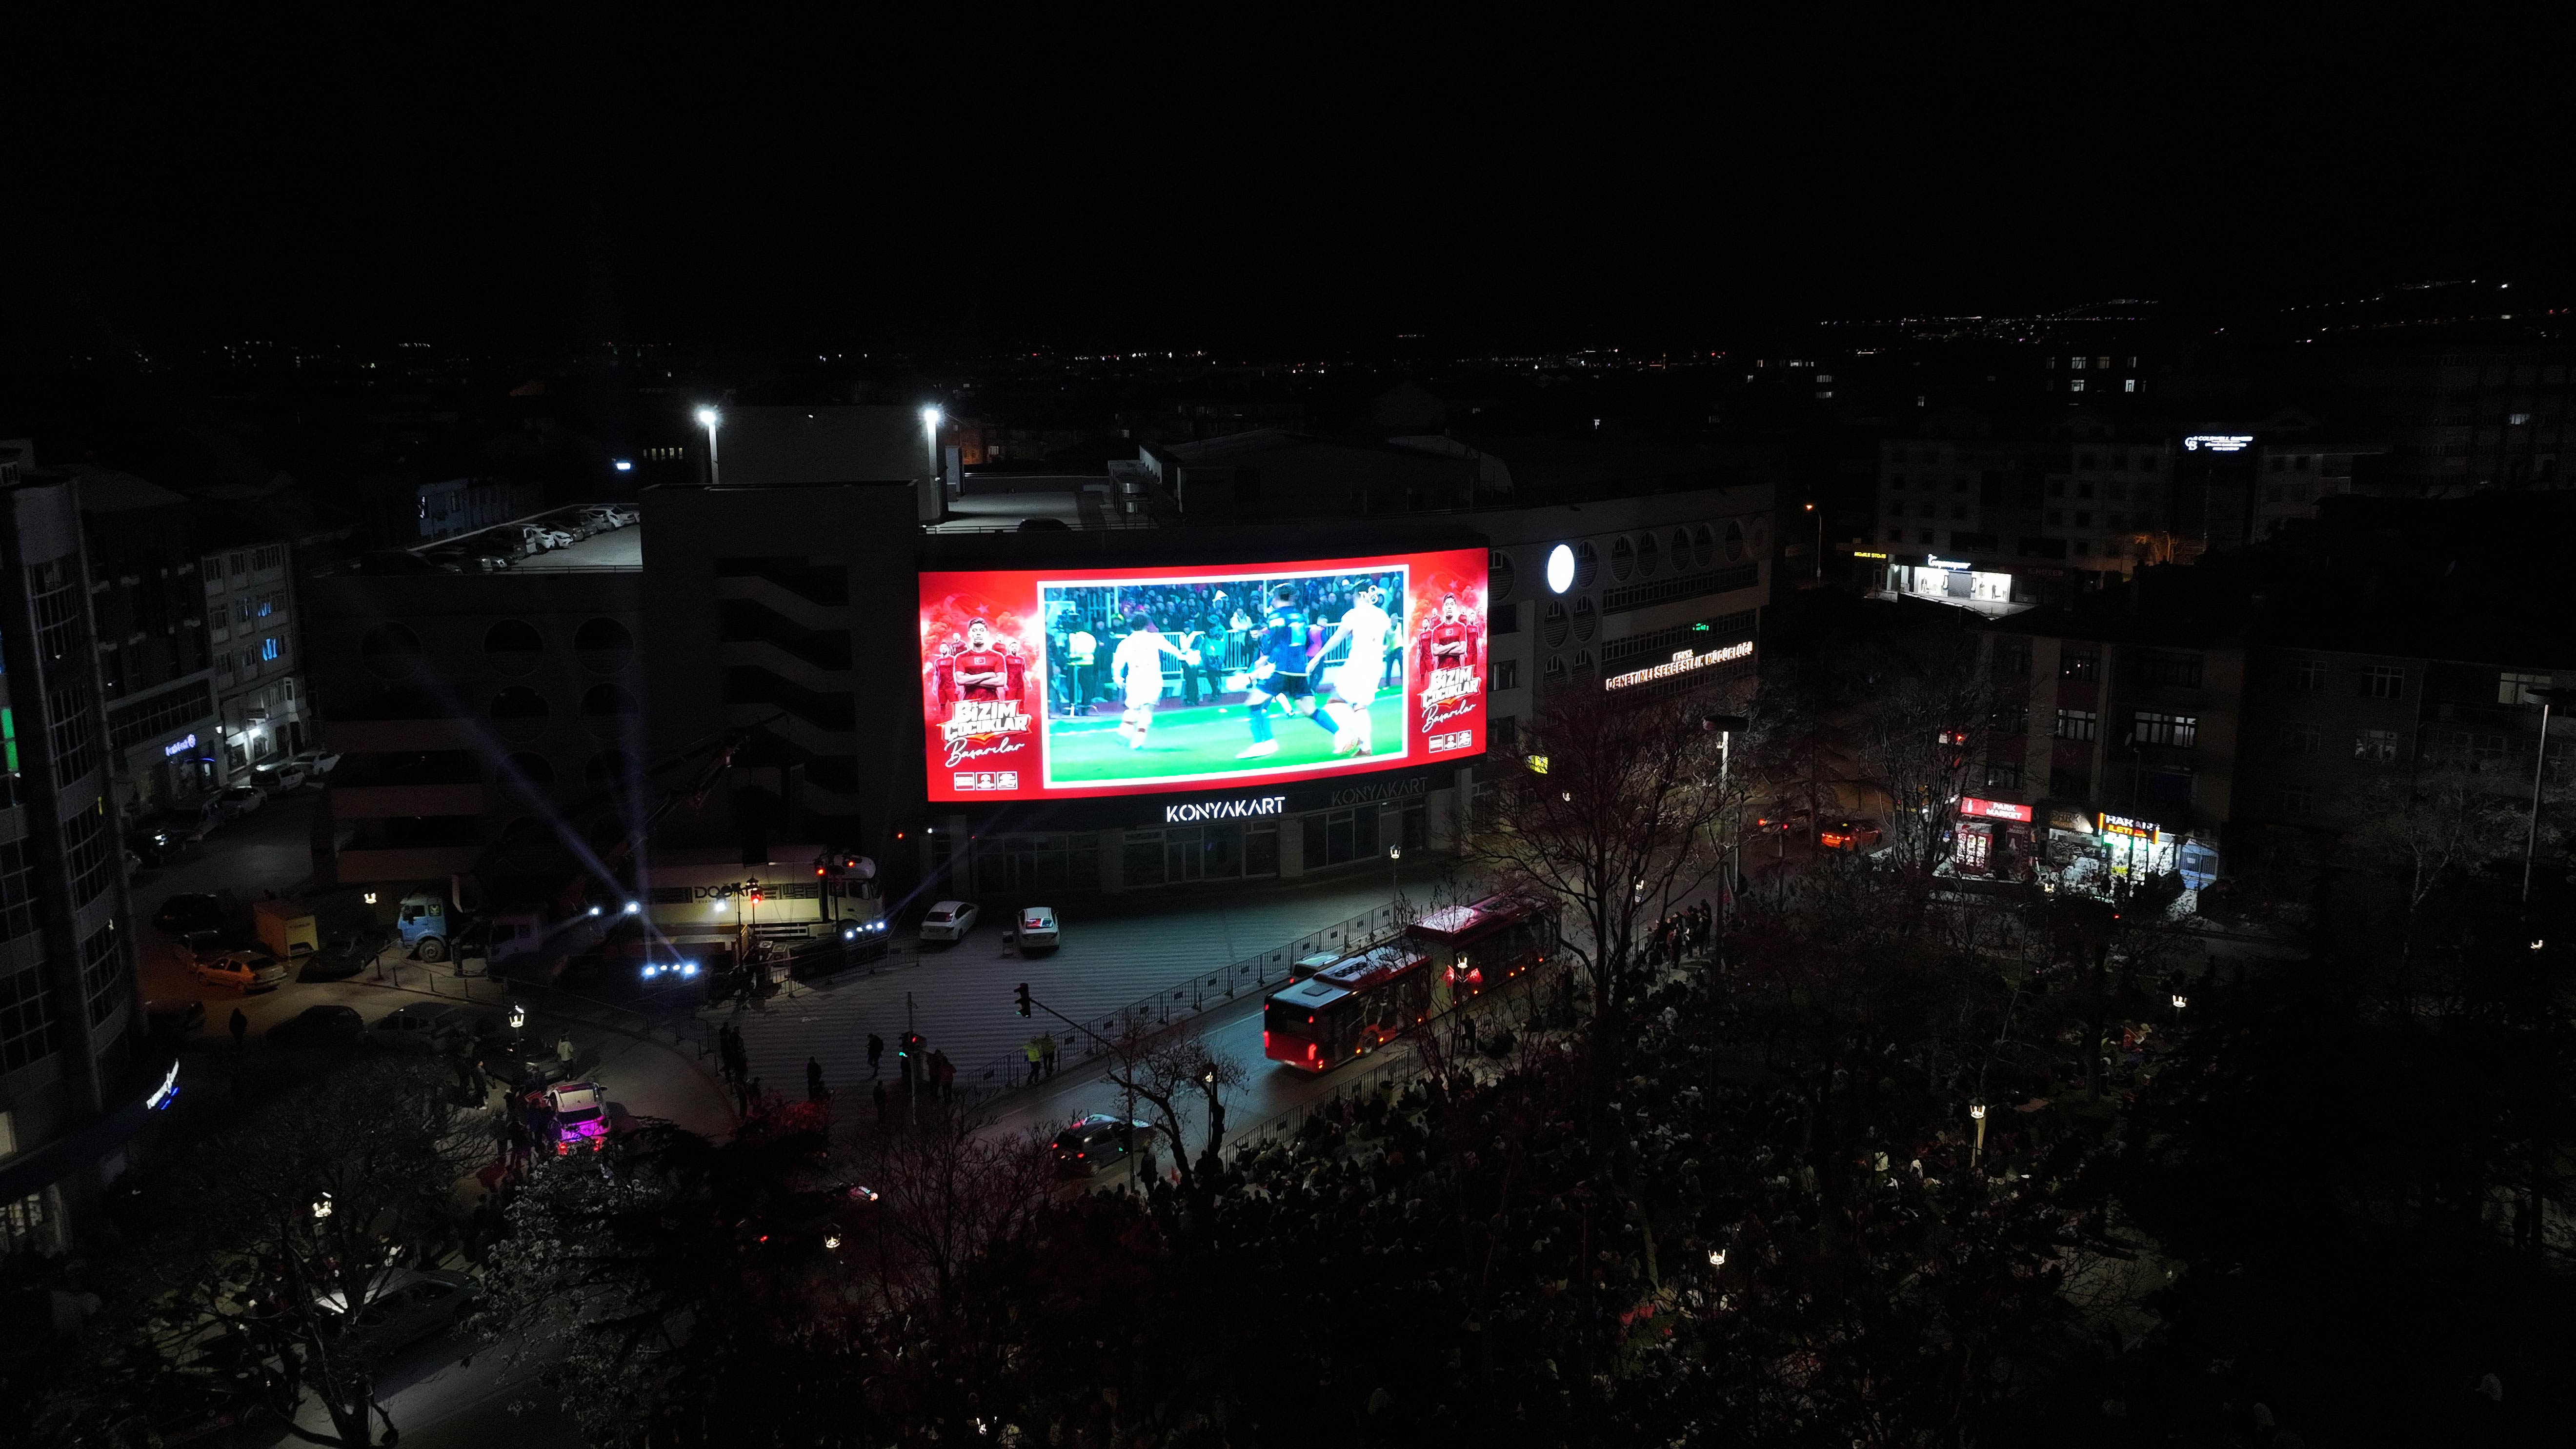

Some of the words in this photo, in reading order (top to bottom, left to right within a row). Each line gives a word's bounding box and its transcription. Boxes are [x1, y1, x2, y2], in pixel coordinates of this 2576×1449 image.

[1430, 666, 1473, 690] BİZİM
[1422, 678, 1480, 709] ÇOCUKLAR
[954, 701, 1017, 723] BİZİM
[944, 716, 1029, 742] ÇOCUKLAR
[1331, 776, 1428, 806] KONYAKART
[1167, 796, 1286, 823] KONYAKART
[1986, 808, 2022, 820] MARKET
[1993, 803, 2016, 812] PARK
